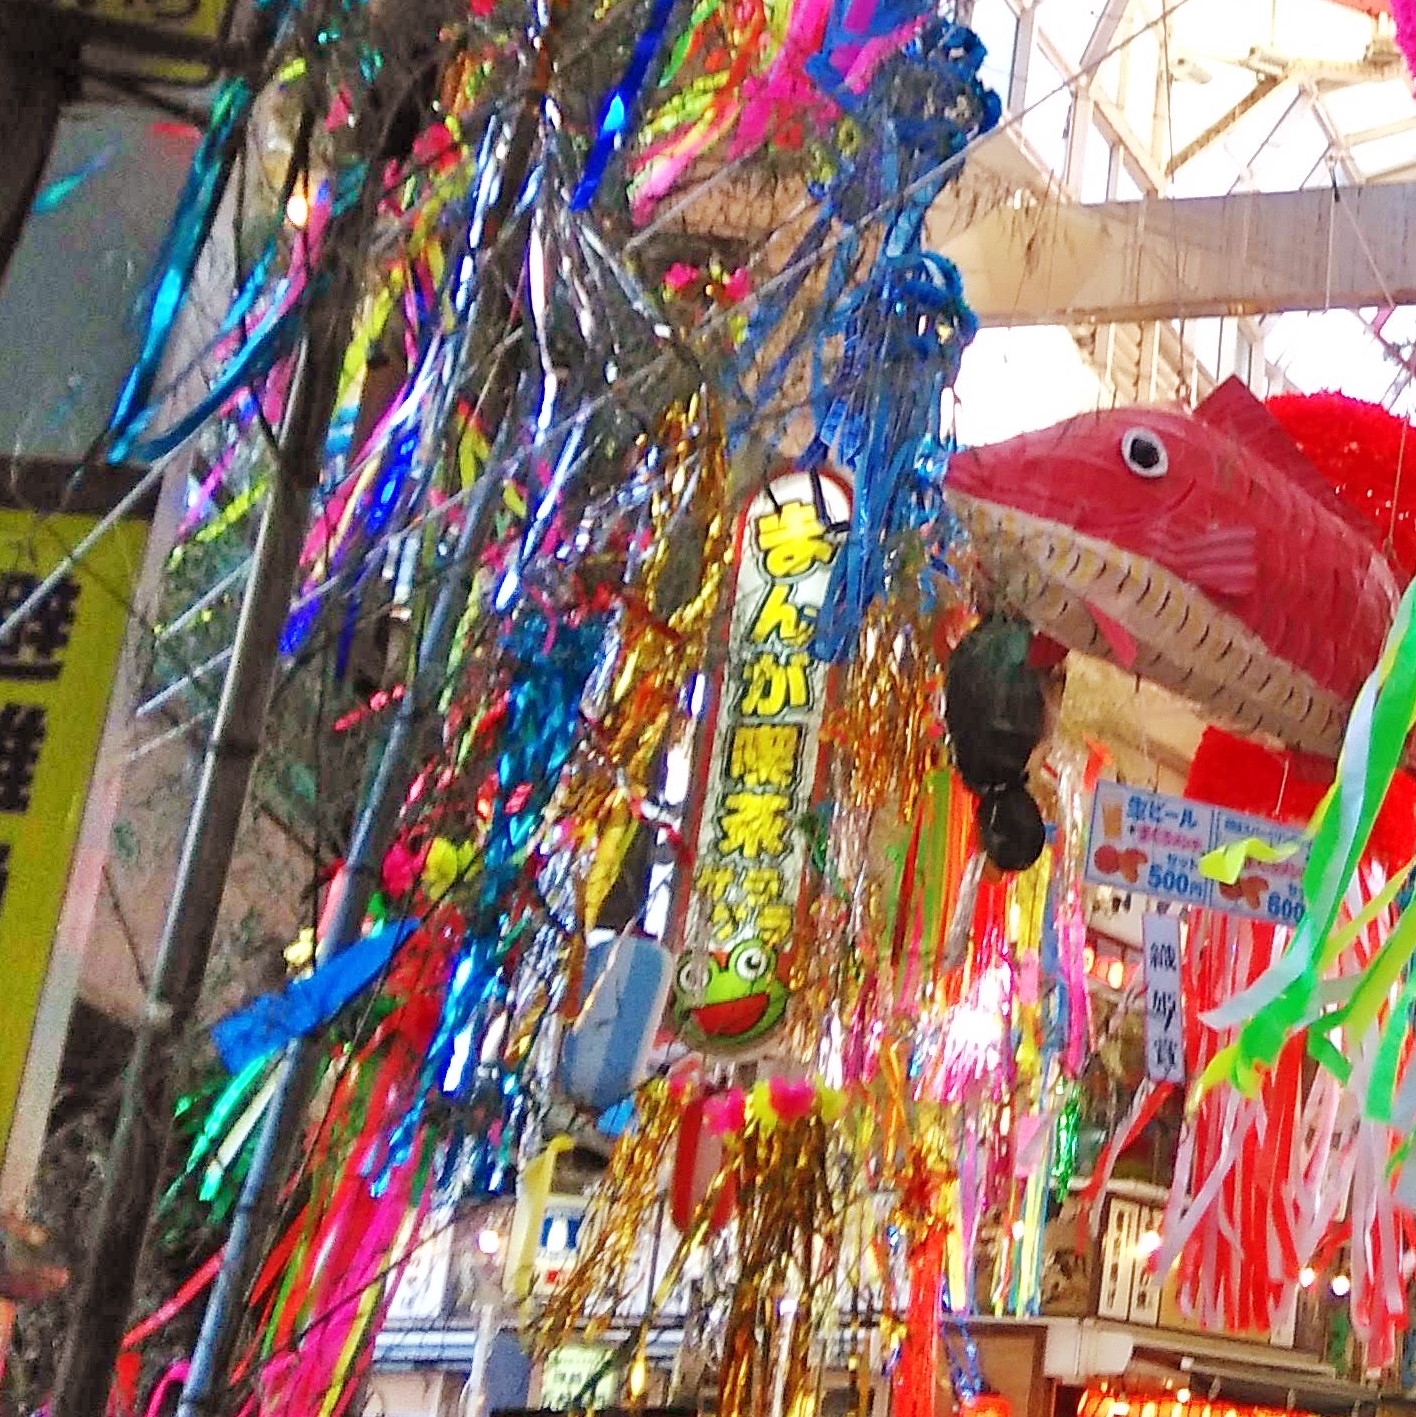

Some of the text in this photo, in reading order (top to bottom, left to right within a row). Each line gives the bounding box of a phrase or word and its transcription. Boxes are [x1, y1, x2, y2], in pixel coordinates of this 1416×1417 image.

[717, 501, 834, 858] まんが喫茶
